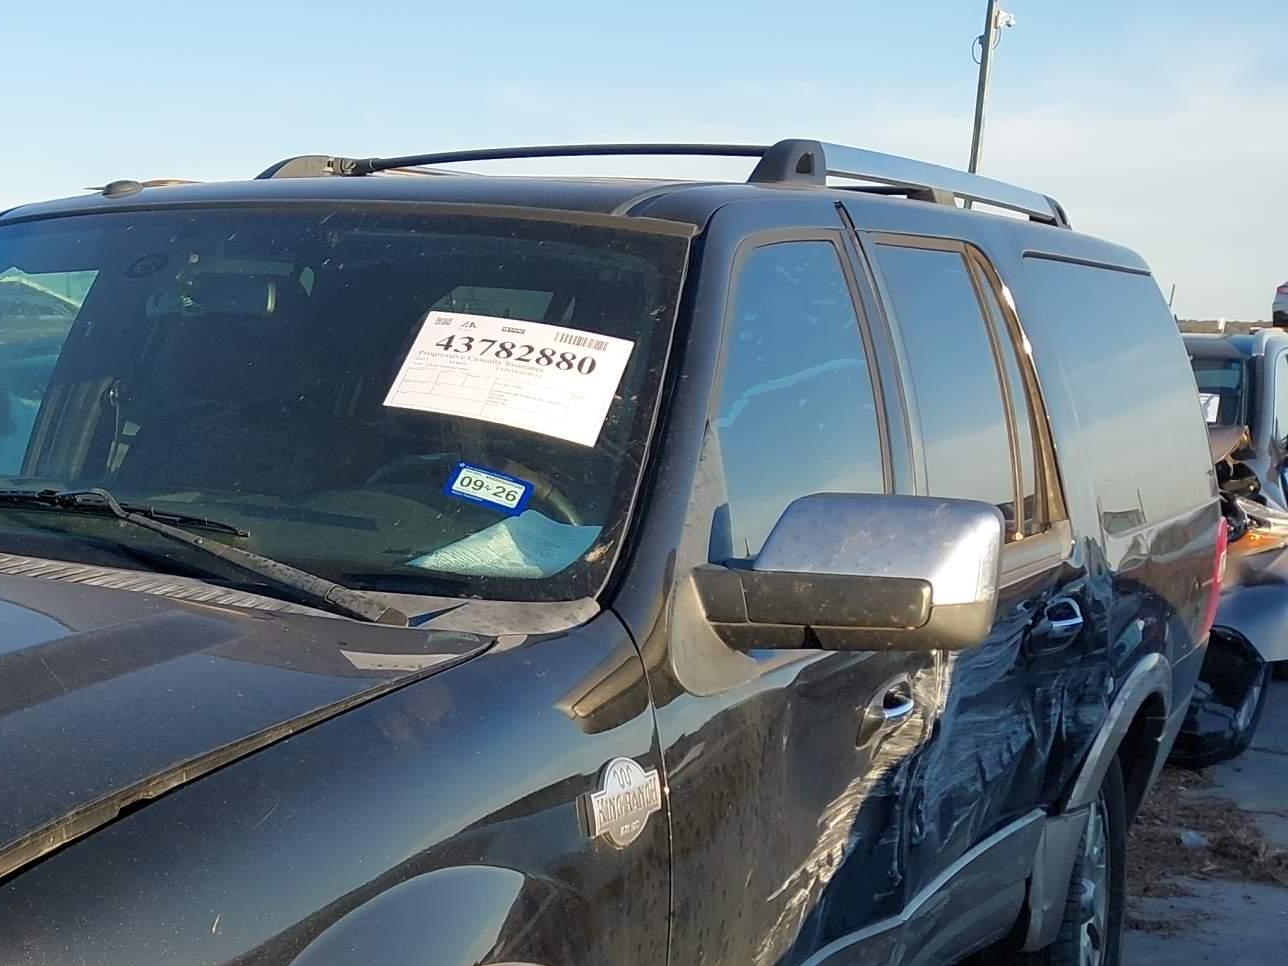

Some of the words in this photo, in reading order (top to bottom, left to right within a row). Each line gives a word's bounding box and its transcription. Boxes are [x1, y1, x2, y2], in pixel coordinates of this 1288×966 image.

[418, 350, 466, 361] Progressive
[468, 356, 503, 367] Casualty
[505, 361, 545, 374] Insurance
[435, 334, 597, 375] 43782880
[460, 475, 485, 491] 09
[492, 485, 519, 503] 26
[597, 794, 624, 824] KING
[626, 777, 660, 815] RANCH
